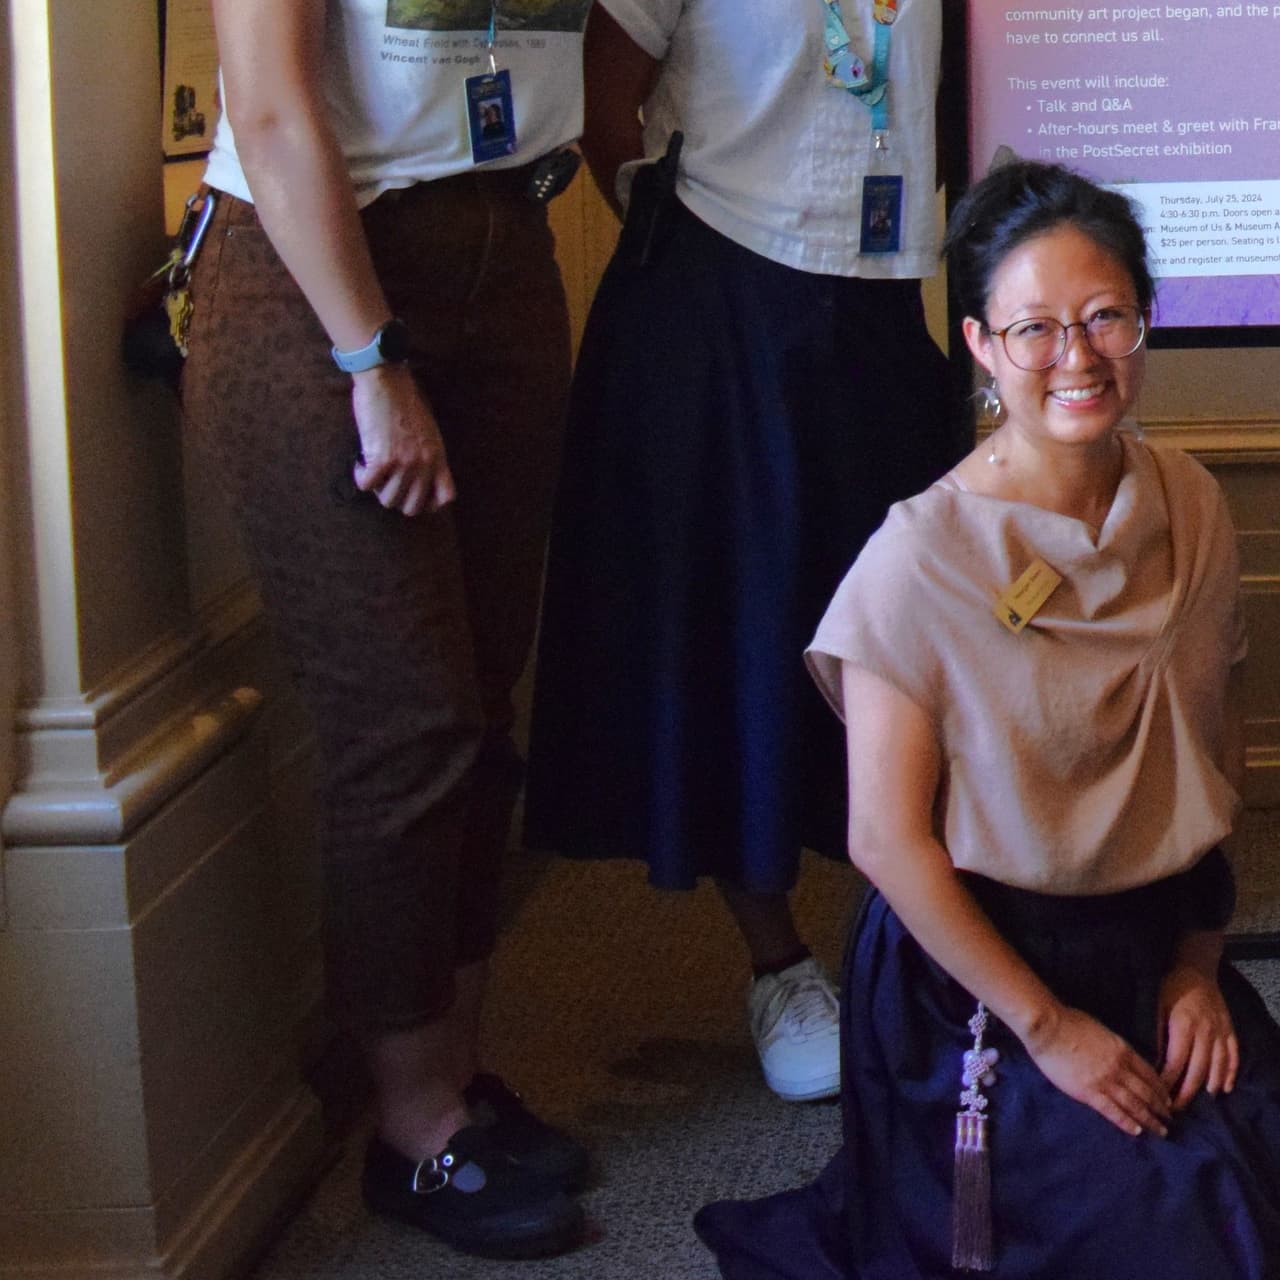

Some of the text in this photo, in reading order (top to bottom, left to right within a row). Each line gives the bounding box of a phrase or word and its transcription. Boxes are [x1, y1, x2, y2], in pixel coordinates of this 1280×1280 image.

[1005, 7, 1084, 23] community
[1088, 8, 1108, 20] art
[1112, 6, 1161, 22] project
[1165, 5, 1213, 21] began,
[1216, 4, 1243, 17] and
[1247, 3, 1269, 16] the
[383, 33, 420, 49] Wheat
[1006, 28, 1165, 45] have to connect us all.
[380, 51, 481, 67] Vincent van Gogh
[1007, 74, 1169, 90] This event will include:
[1036, 98, 1133, 113] Talk and Q&A
[1037, 122, 1119, 136] After-hours
[1123, 121, 1158, 134] meet
[1162, 119, 1173, 133] &
[1177, 120, 1215, 136] greet
[1219, 118, 1249, 132] with
[1039, 142, 1232, 158] in the PostSecret exhibition
[1160, 193, 1262, 205] Thursday, July 25, 2024
[1160, 209, 1200, 218] 4:30-6:30
[1201, 210, 1220, 219] p.m.
[1223, 208, 1249, 217] Doors
[1251, 208, 1273, 218] open
[1160, 224, 1198, 233] Museum
[1199, 223, 1208, 232] of
[1210, 223, 1222, 232] Us
[1224, 222, 1232, 231] &
[1234, 222, 1272, 231] Museum
[1160, 238, 1177, 247] $25
[1179, 239, 1193, 248] per
[1196, 238, 1229, 248] person.
[1231, 235, 1265, 245] Seating
[1266, 236, 1274, 244] is
[1169, 256, 1186, 265] and
[1188, 255, 1222, 266] register
[1224, 255, 1233, 263] at
